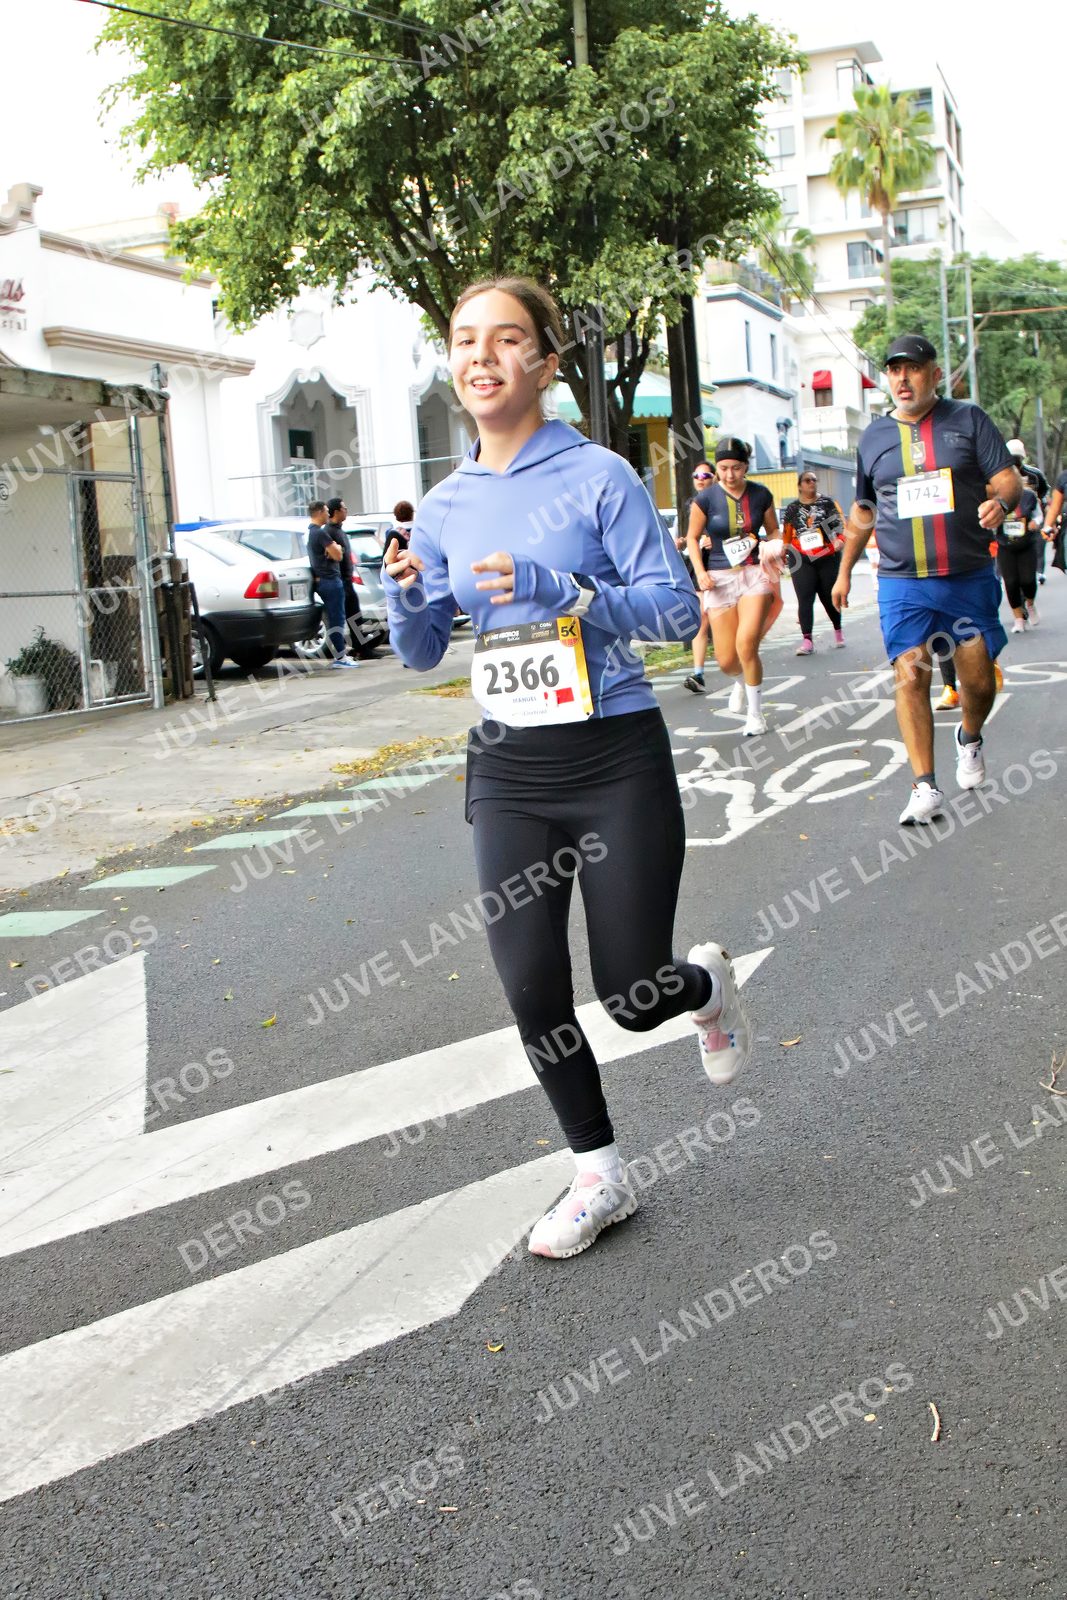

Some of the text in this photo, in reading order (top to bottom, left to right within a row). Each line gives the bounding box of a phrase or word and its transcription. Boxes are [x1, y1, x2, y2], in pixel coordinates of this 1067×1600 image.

[906, 485, 940, 501] 1742
[730, 539, 752, 555] 6237
[483, 654, 560, 695] 2366
